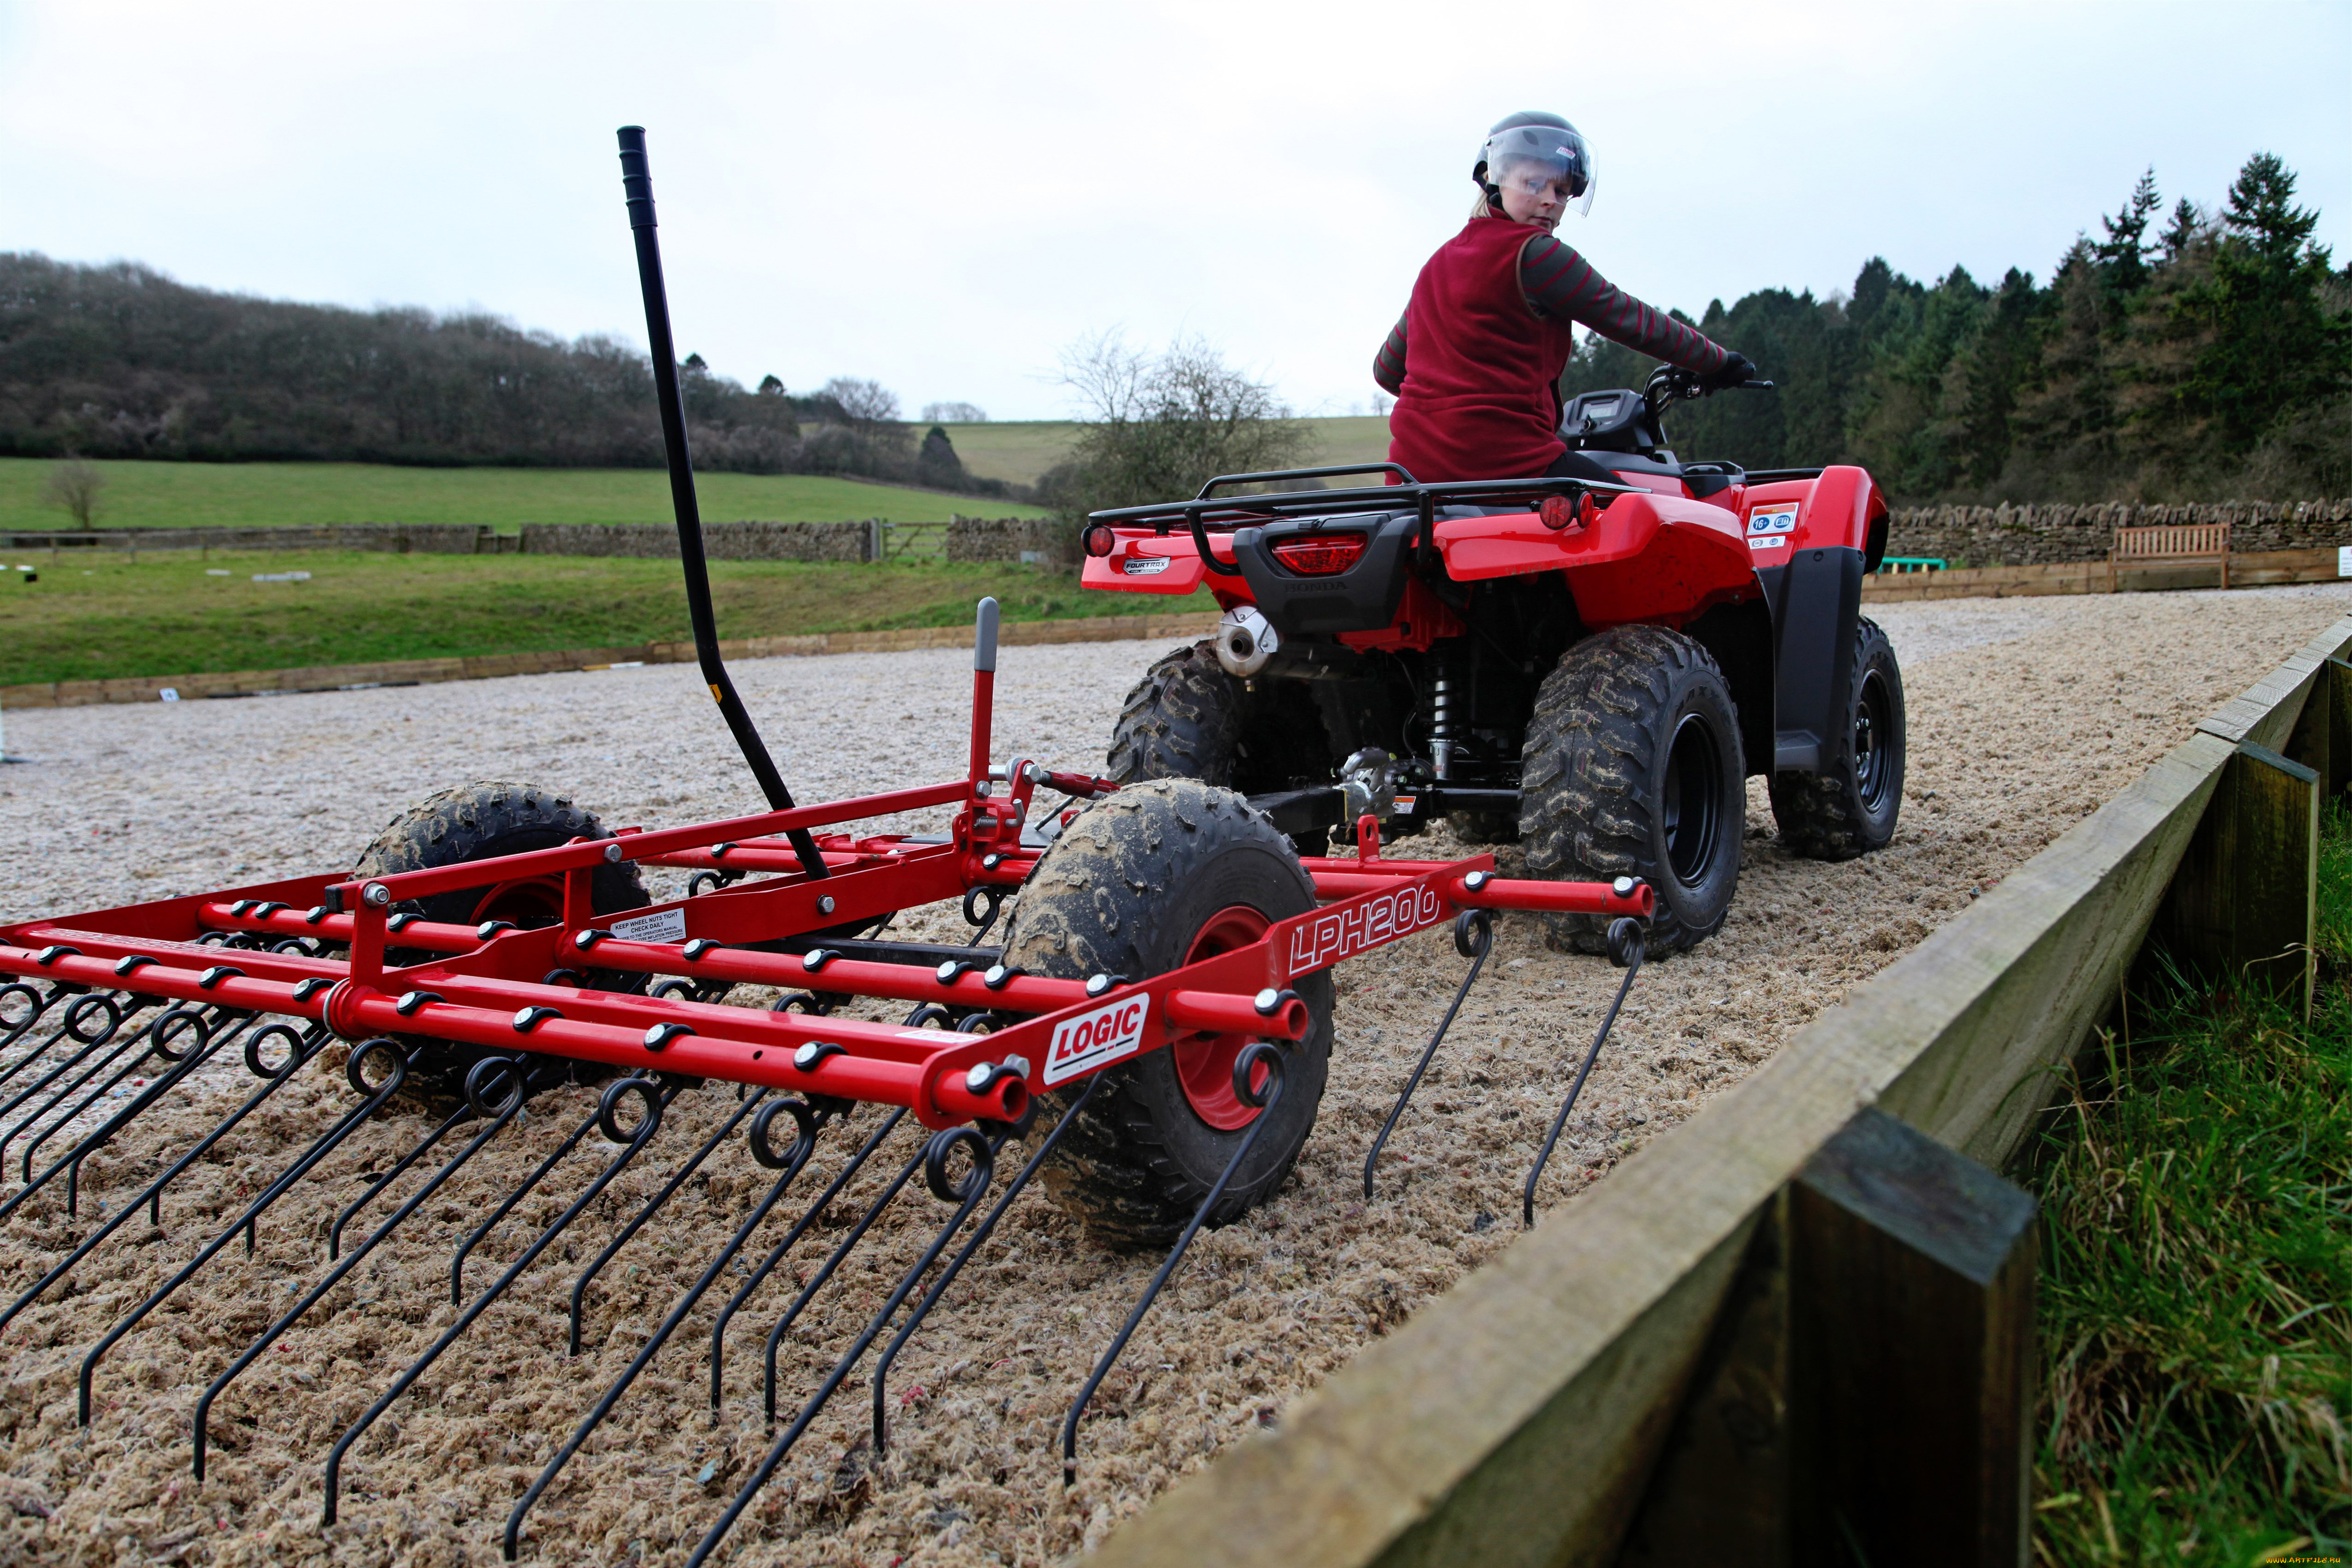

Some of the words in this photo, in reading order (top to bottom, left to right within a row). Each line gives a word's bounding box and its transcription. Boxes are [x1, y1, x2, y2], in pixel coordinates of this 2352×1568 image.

[1755, 519, 1767, 529] 16+
[1285, 582, 1349, 593] HONDA
[643, 928, 663, 936] OPERATORS
[1289, 884, 1440, 975] LPH200
[1055, 1003, 1140, 1062] LOGIC
